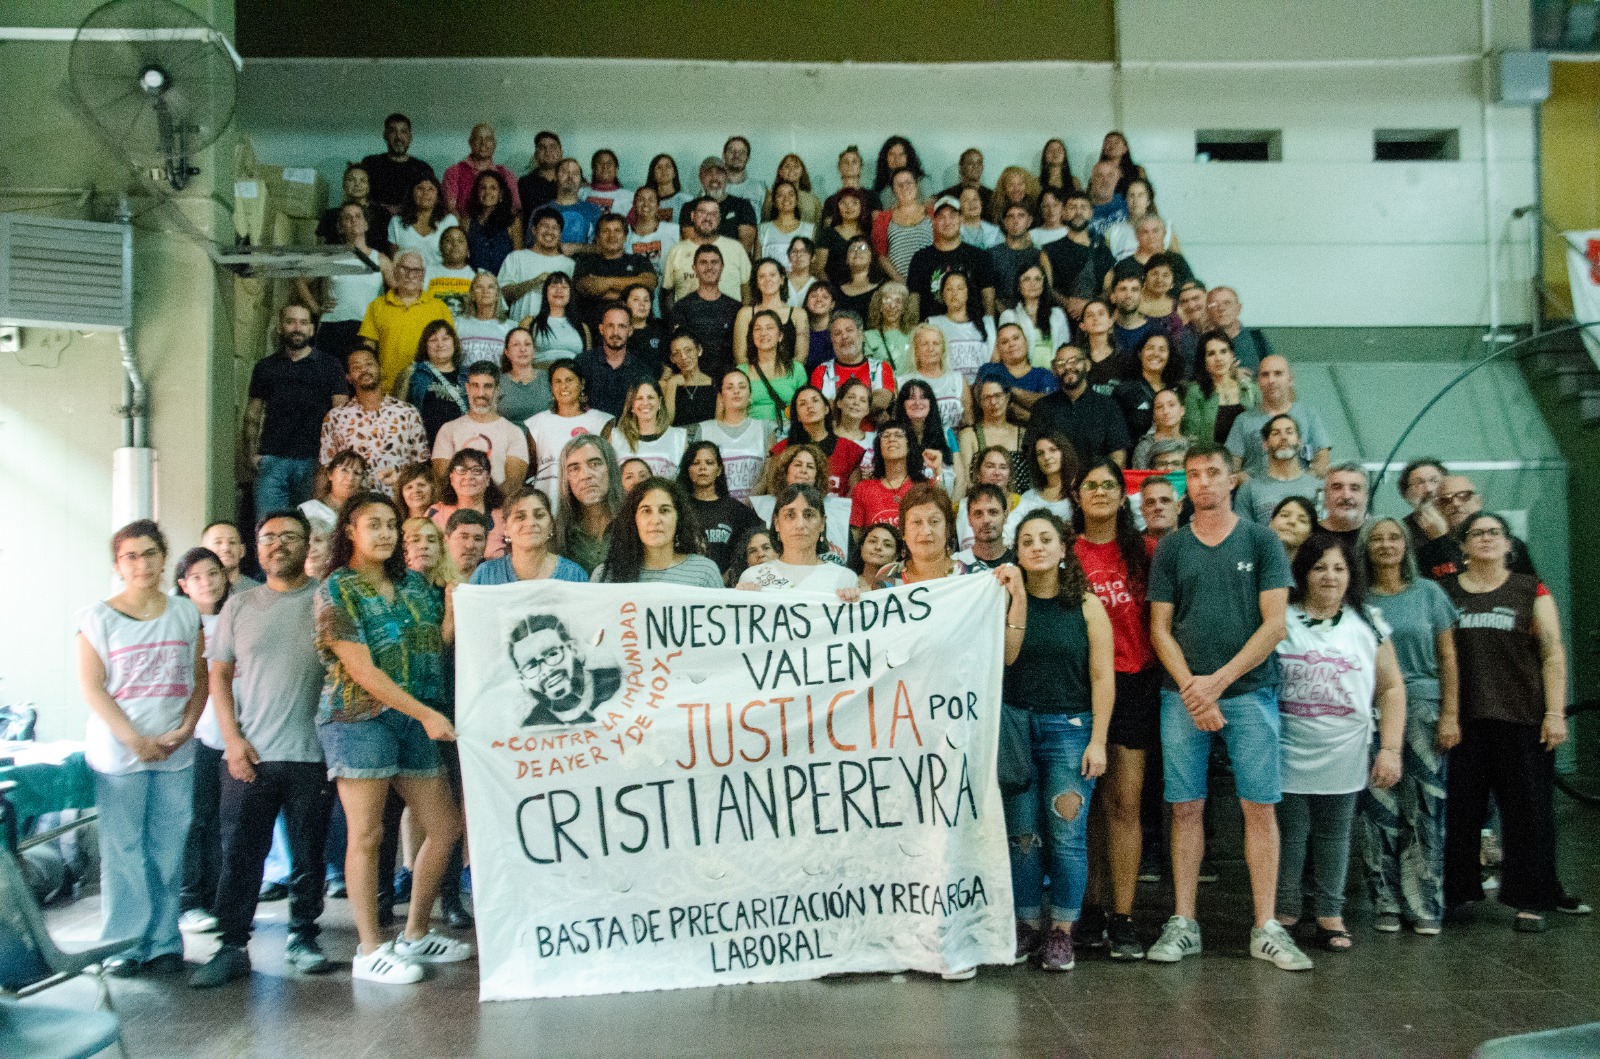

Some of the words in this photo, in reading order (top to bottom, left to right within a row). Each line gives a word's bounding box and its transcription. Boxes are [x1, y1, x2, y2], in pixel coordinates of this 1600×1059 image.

[1093, 579, 1124, 593] ista
[1099, 590, 1131, 608] oja
[646, 603, 811, 649] NUESTRAS
[822, 586, 932, 635] VIDAS
[602, 711, 624, 731] LA
[620, 601, 645, 708] IMPUNIDAD
[742, 638, 872, 690] VALEN
[1278, 662, 1342, 683] RIBUNA
[516, 760, 543, 779] DE
[548, 746, 609, 776] AYER
[611, 734, 625, 755] Y
[625, 714, 654, 745] DE
[675, 679, 923, 770] JUSTICIA
[929, 691, 978, 720] POR
[537, 916, 628, 958] BASTA
[632, 909, 666, 944] DE
[669, 883, 867, 938] PRECARIZACIÓN
[869, 884, 886, 915] Y
[892, 875, 989, 917] RECARGA
[710, 929, 834, 973] LABORAL
